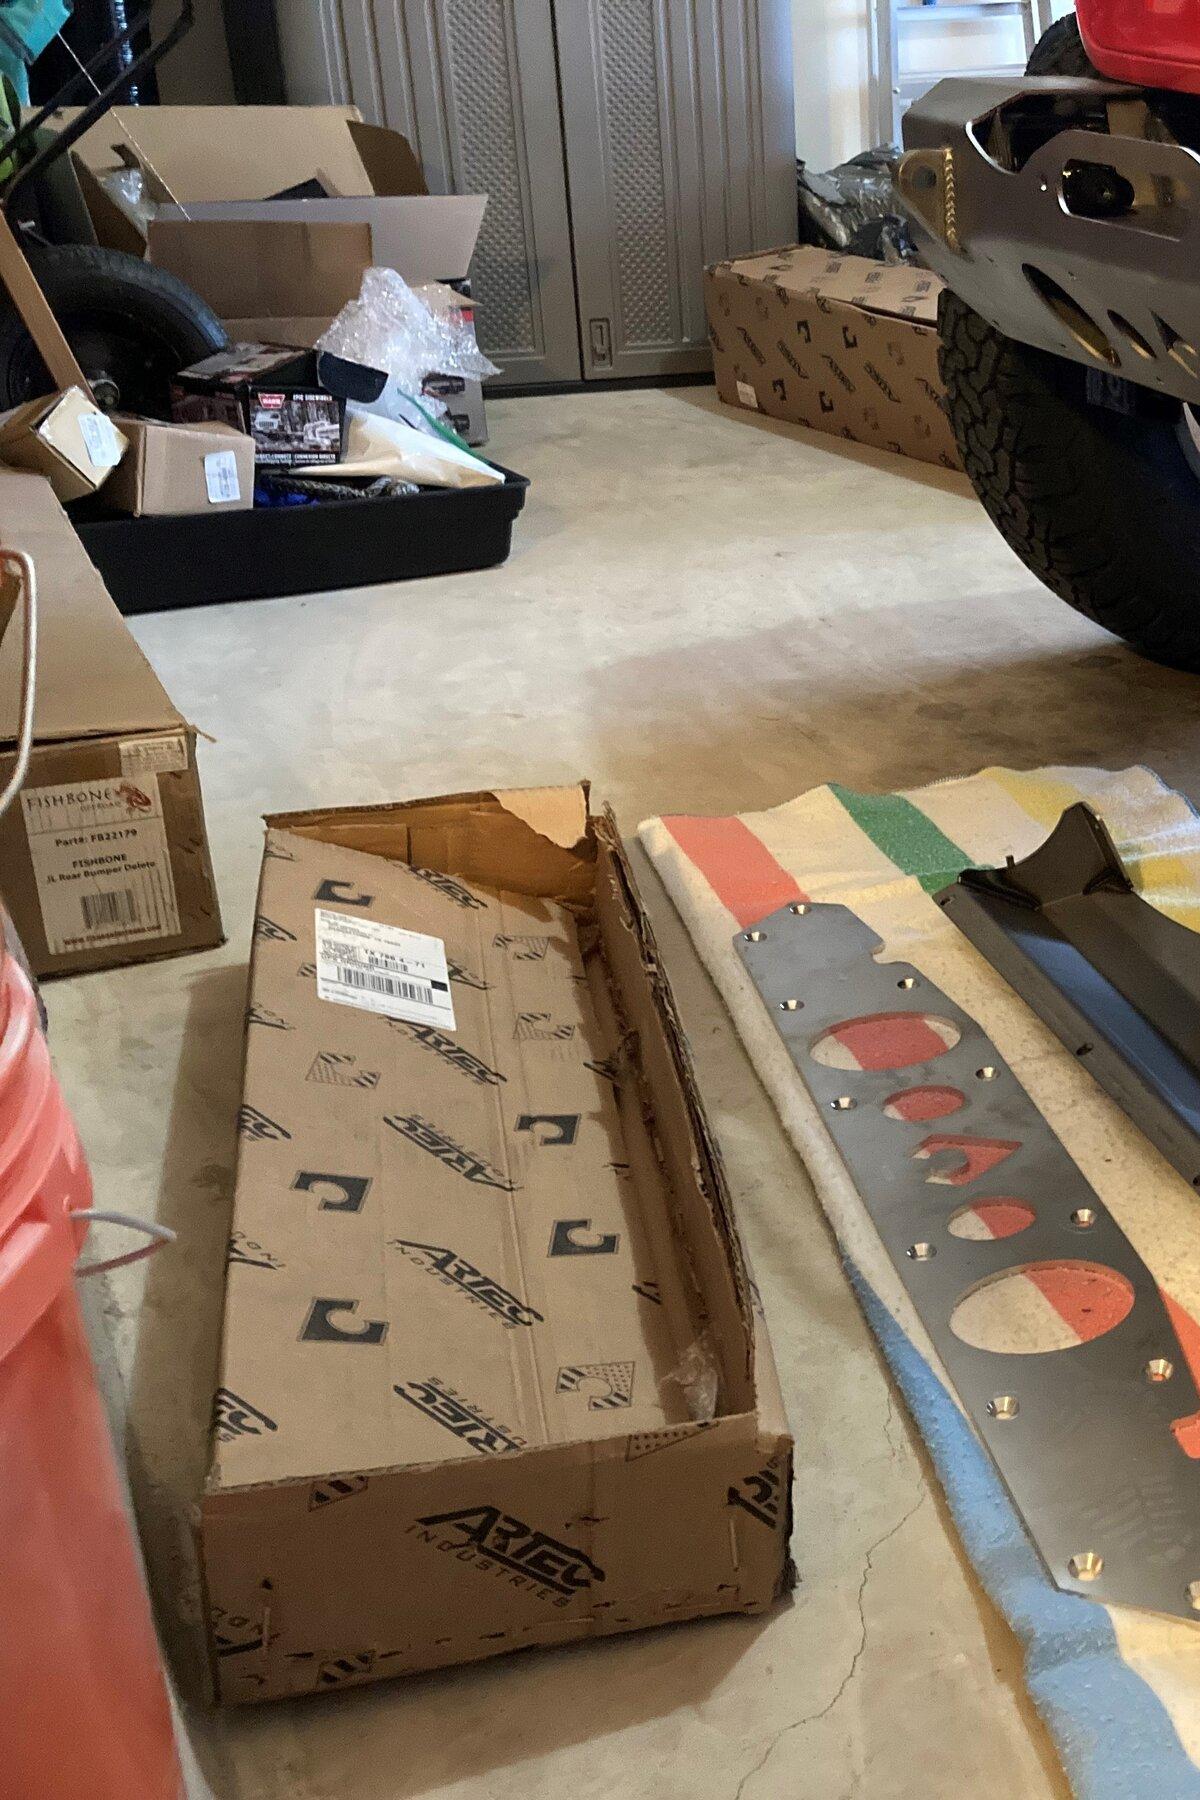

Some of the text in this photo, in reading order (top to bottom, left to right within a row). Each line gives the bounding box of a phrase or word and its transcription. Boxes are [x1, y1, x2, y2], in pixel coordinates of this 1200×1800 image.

[26, 787, 112, 812] FISHBONE
[90, 828, 138, 843] FB22179
[58, 872, 81, 882] Rear
[83, 866, 122, 878] Bumper
[124, 861, 156, 872] Delete
[72, 853, 128, 869] FISHBONE
[395, 1238, 544, 1326] ARTEC
[415, 1505, 607, 1597] ARTEC
[404, 1524, 572, 1608] INDUSTRIES
